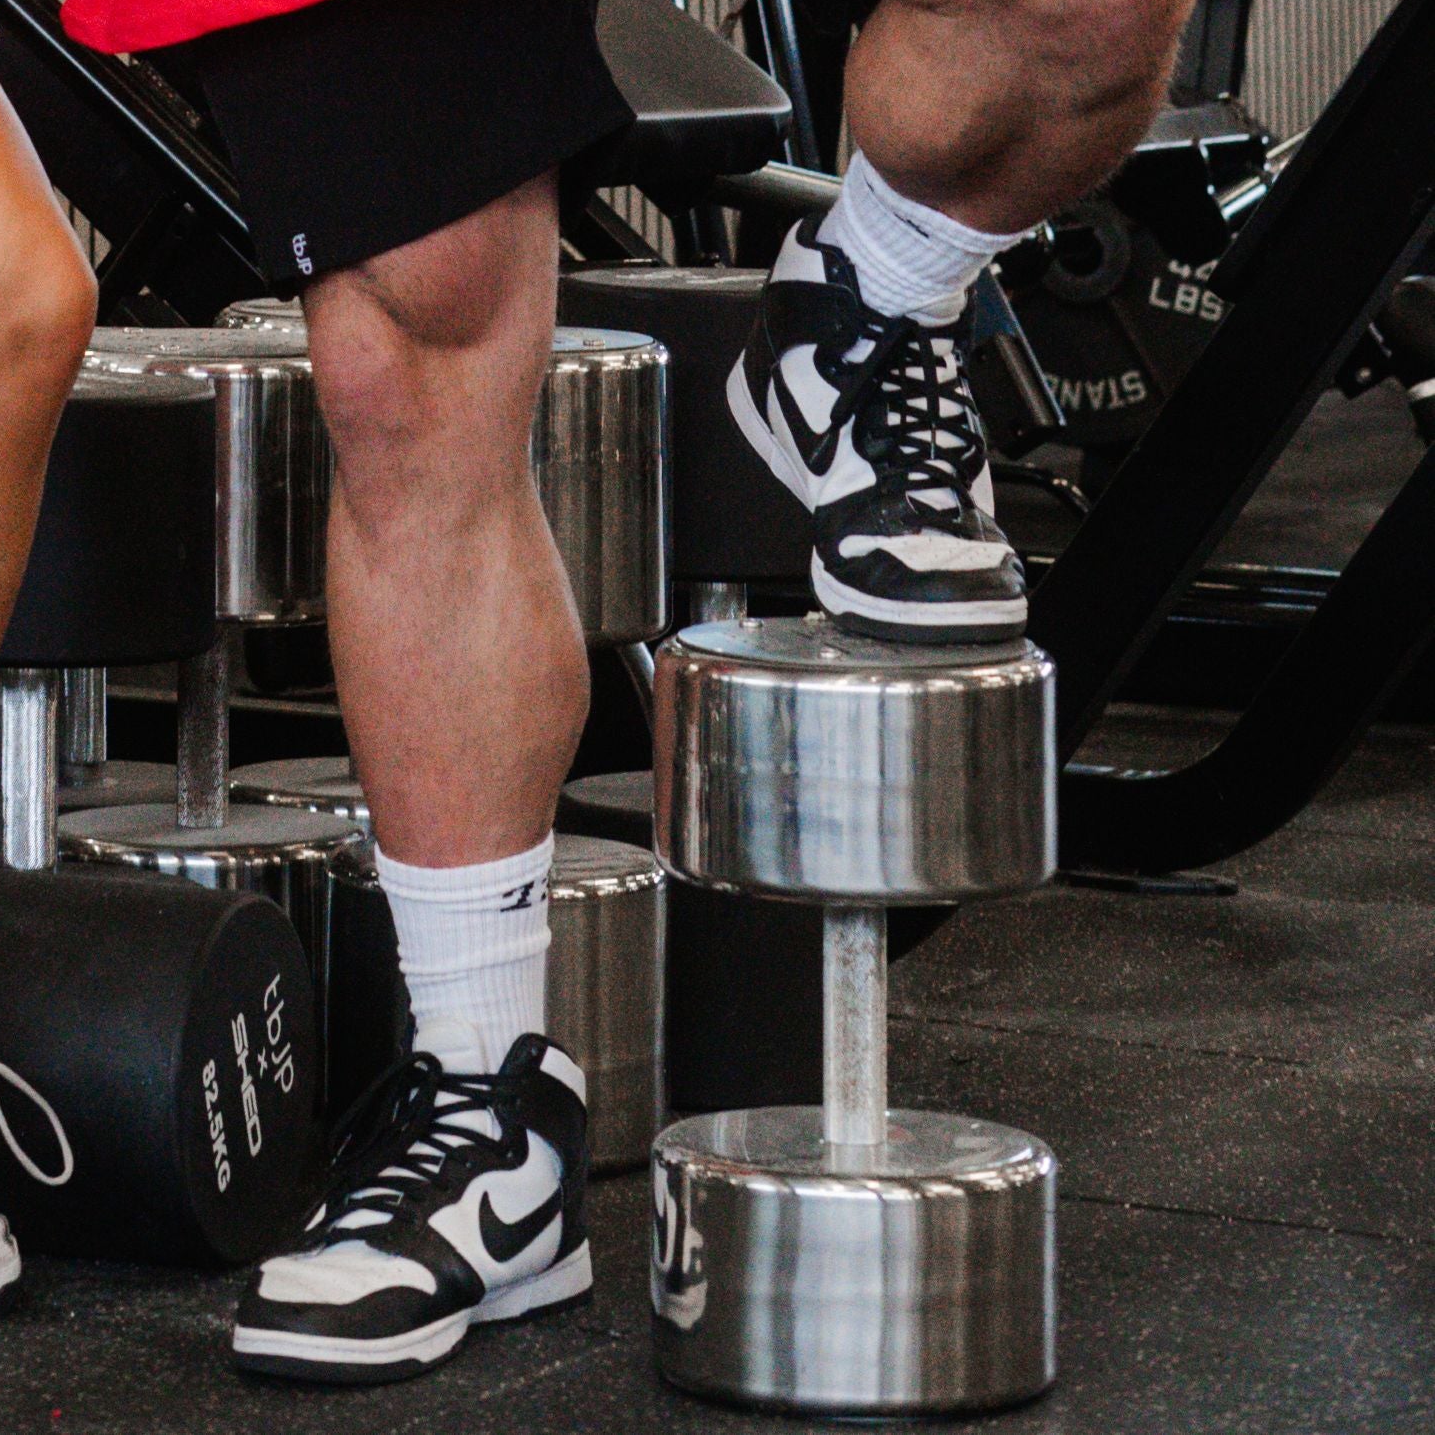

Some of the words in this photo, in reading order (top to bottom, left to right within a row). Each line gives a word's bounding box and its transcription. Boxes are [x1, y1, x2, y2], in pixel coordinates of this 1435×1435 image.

[1148, 276, 1225, 322] LBS
[202, 1058, 232, 1193] 82.5KG
[231, 1012, 262, 1158] SHED
